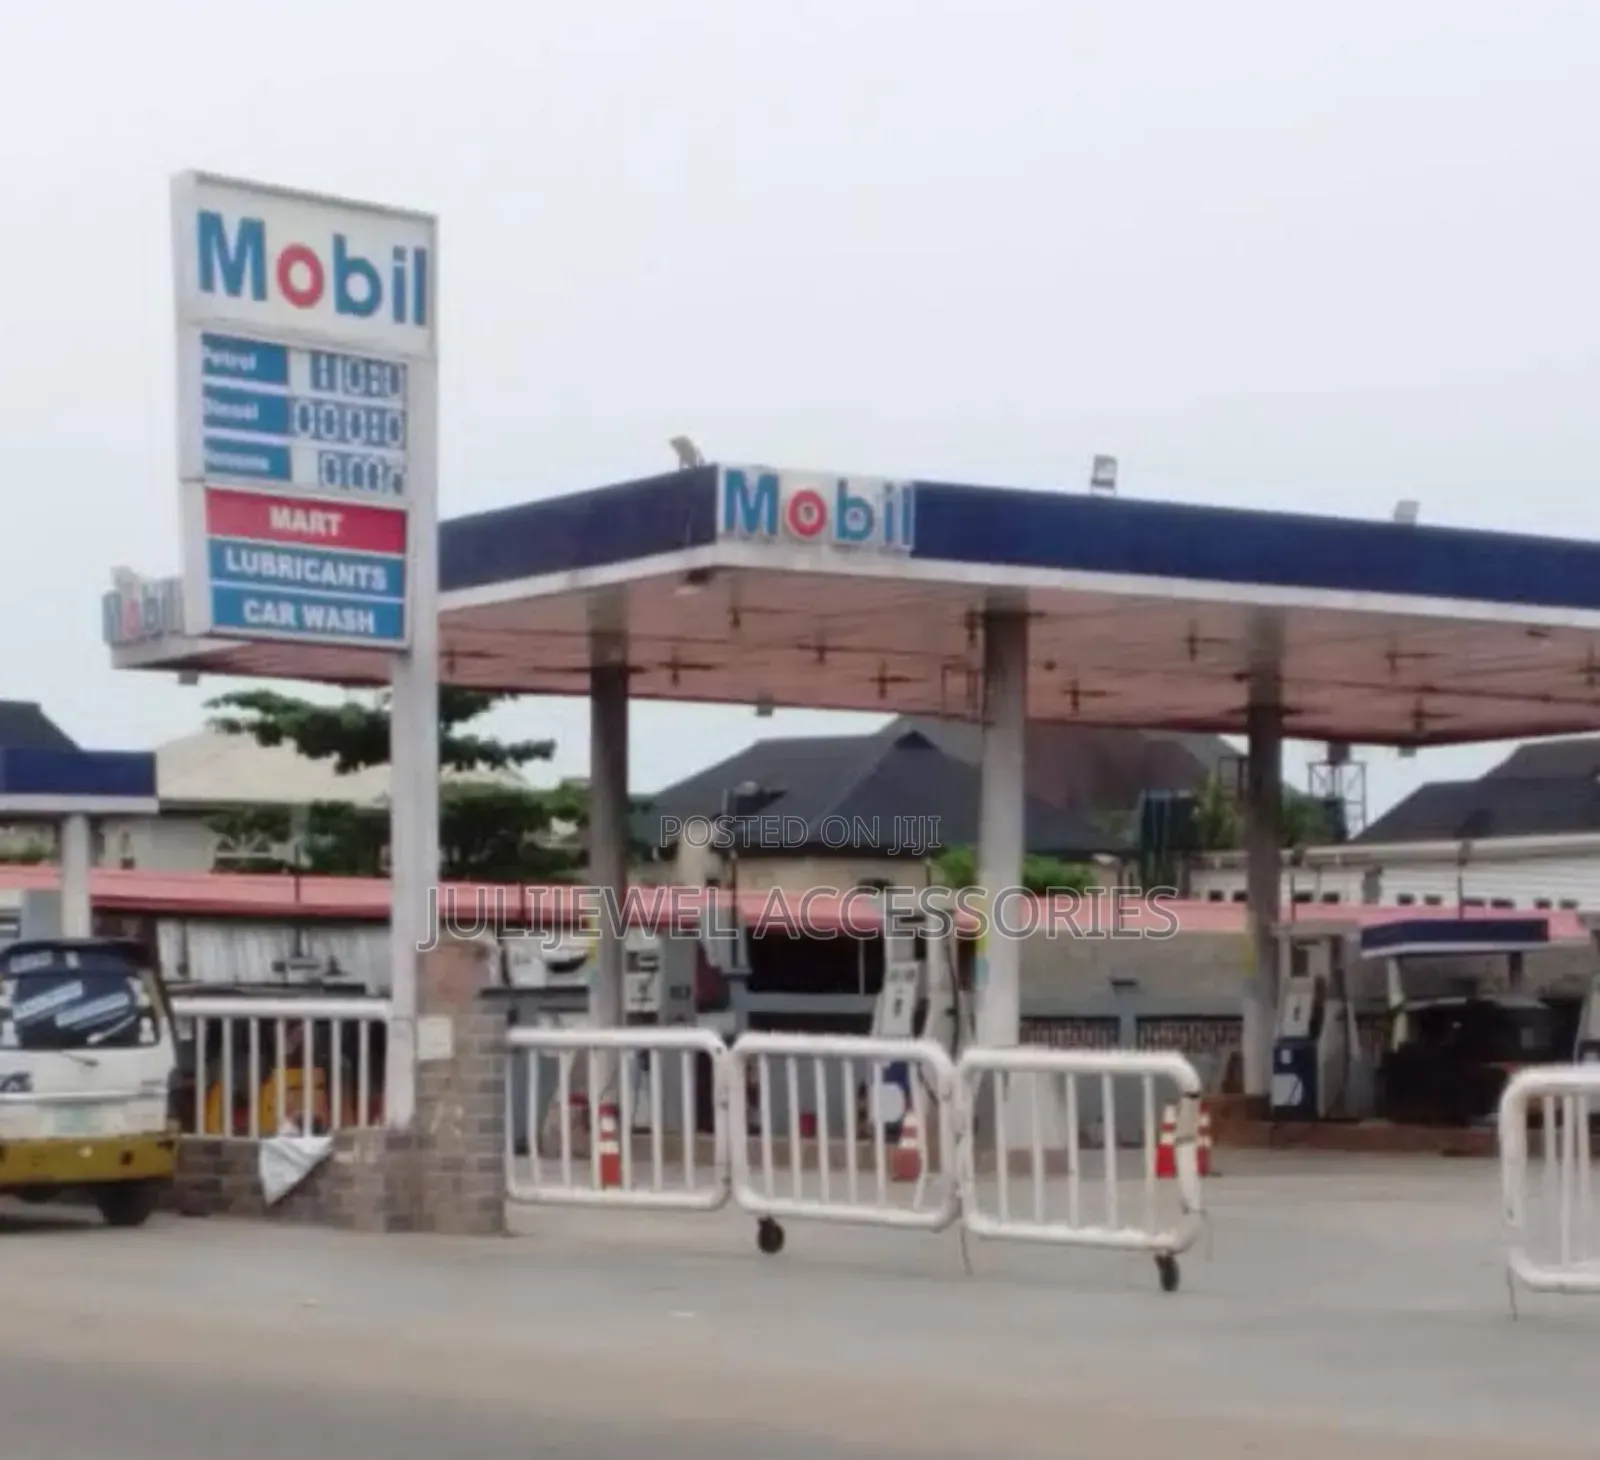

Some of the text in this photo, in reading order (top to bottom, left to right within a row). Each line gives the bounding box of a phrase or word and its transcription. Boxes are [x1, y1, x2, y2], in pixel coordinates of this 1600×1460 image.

[196, 207, 427, 326] Mobil
[269, 504, 343, 537] MART
[723, 469, 912, 548] Mobil
[225, 547, 387, 592] LUBRICANTS
[243, 598, 376, 634] CAR WASH
